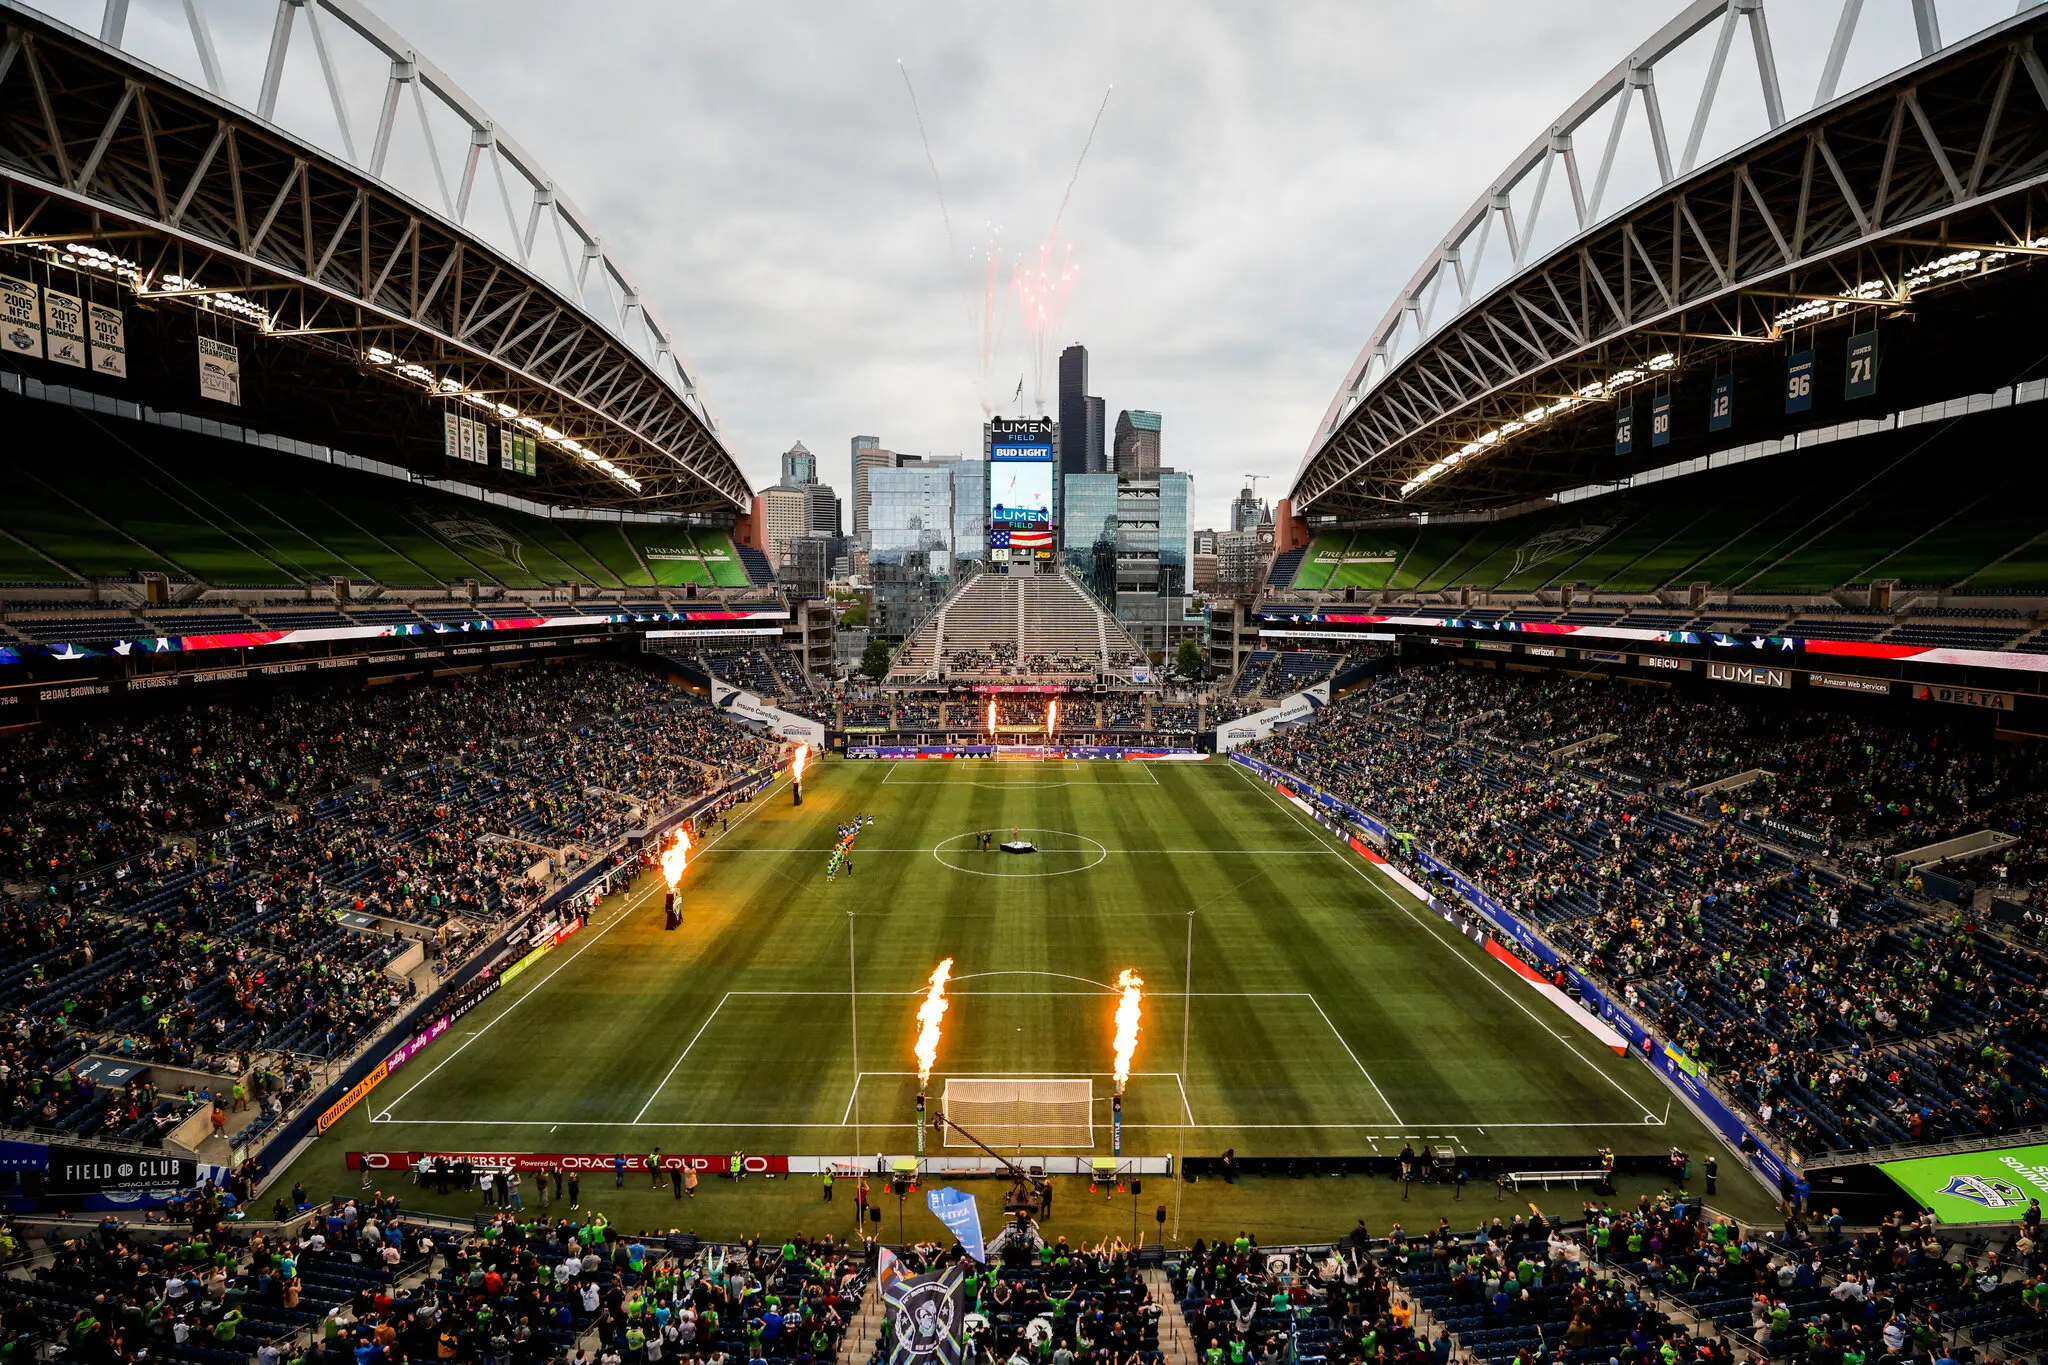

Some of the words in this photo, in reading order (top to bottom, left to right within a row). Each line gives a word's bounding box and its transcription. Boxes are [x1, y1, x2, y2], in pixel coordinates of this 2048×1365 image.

[4, 293, 33, 311] 2005
[9, 306, 30, 320] NFC
[51, 308, 77, 324] 2013
[0, 314, 40, 331] CHAMPIONS
[56, 321, 75, 333] NFC
[95, 321, 118, 336] 2014
[47, 328, 84, 343] CHAMPIONS
[99, 333, 116, 344] NFC
[91, 340, 125, 354] CHAMPIONS
[200, 338, 215, 349] 2013
[216, 343, 236, 355] WORLD
[1852, 345, 1872, 356] JONES
[200, 346, 236, 363] CHAMPIONS
[1850, 356, 1871, 384] 71
[1788, 373, 1810, 399] 96
[1713, 395, 1729, 418] 12
[992, 423, 1052, 433] LUMEN
[1654, 414, 1668, 434] 80
[1617, 425, 1631, 443] 45
[996, 448, 1017, 457] BUD
[1018, 448, 1048, 457] LIGHT
[993, 509, 1048, 522] LUMEN
[1009, 521, 1034, 529] FIELD
[644, 546, 707, 555] PREMERA
[1319, 550, 1377, 558] PREMERA
[1531, 647, 1555, 657] verizon
[268, 665, 279, 674] PAUL
[285, 664, 297, 673] ALLEN
[1711, 664, 1783, 687] LUMEN
[132, 680, 146, 690] PETE
[147, 679, 165, 688] GROSS
[194, 674, 203, 683] 28
[203, 672, 216, 682] CURT
[217, 671, 237, 680] WARNER
[1810, 674, 1823, 682] aws
[1823, 678, 1846, 687] Amazon
[1847, 680, 1861, 688] Web
[1862, 682, 1887, 692] Services
[40, 691, 52, 701] 22
[52, 688, 70, 699] DAVE
[70, 686, 95, 697] BROWN
[1940, 688, 2004, 708] DELTA
[736, 701, 755, 713] Insure
[755, 708, 781, 722] Carefully
[1260, 714, 1279, 725] Dream
[1279, 704, 1308, 718] Fearlessly
[1768, 820, 1790, 832] DELTA
[482, 980, 500, 997] DELTA
[455, 999, 475, 1017] DELTA
[320, 1084, 363, 1130] Continental
[369, 1067, 385, 1085] TIRE
[500, 1156, 517, 1167] FC
[549, 1160, 558, 1168] by
[66, 1163, 111, 1181] FIELD
[139, 1160, 180, 1177] CLUB
